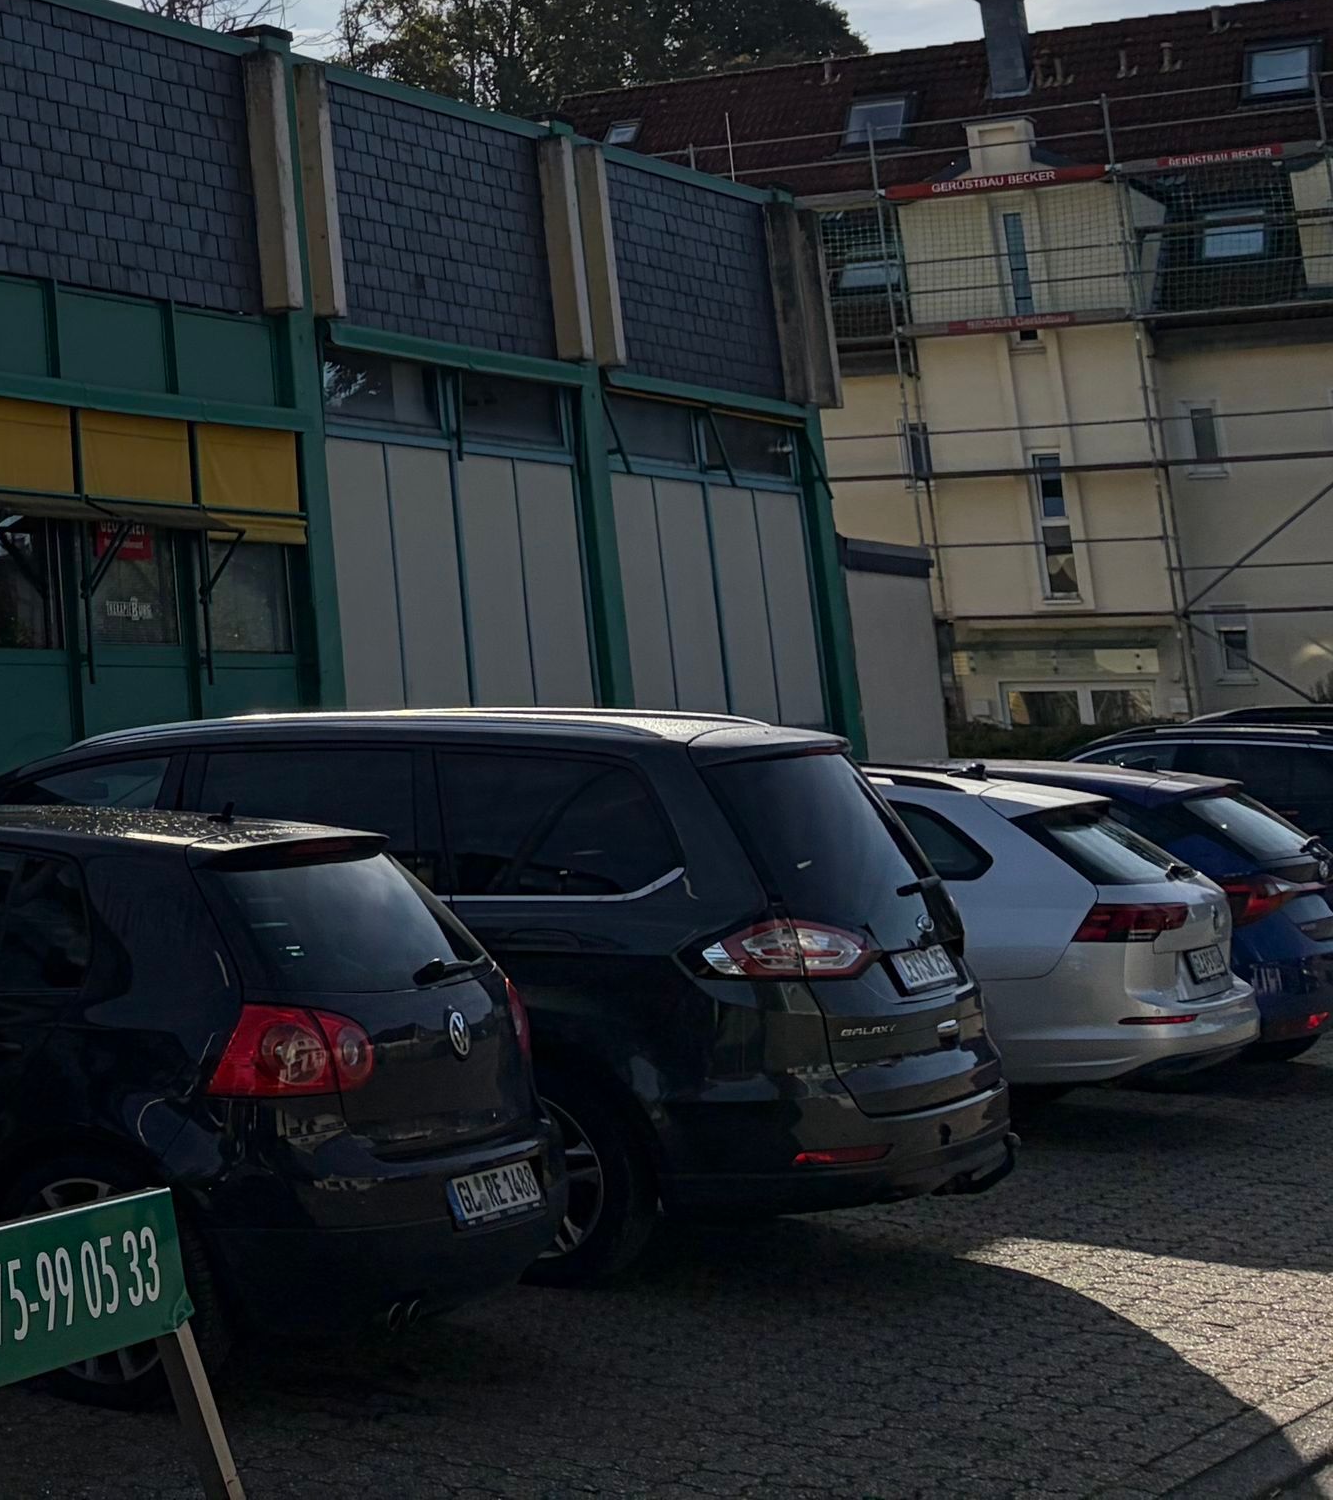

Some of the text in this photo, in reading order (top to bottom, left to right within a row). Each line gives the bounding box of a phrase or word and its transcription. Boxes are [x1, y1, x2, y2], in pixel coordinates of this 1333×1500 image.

[931, 170, 1057, 194] GERÜSTBAU BECKER
[840, 1023, 897, 1037] GALAXY
[456, 1164, 539, 1214] GL RE 1488
[80, 1234, 120, 1319] 05
[122, 1226, 162, 1308] 33
